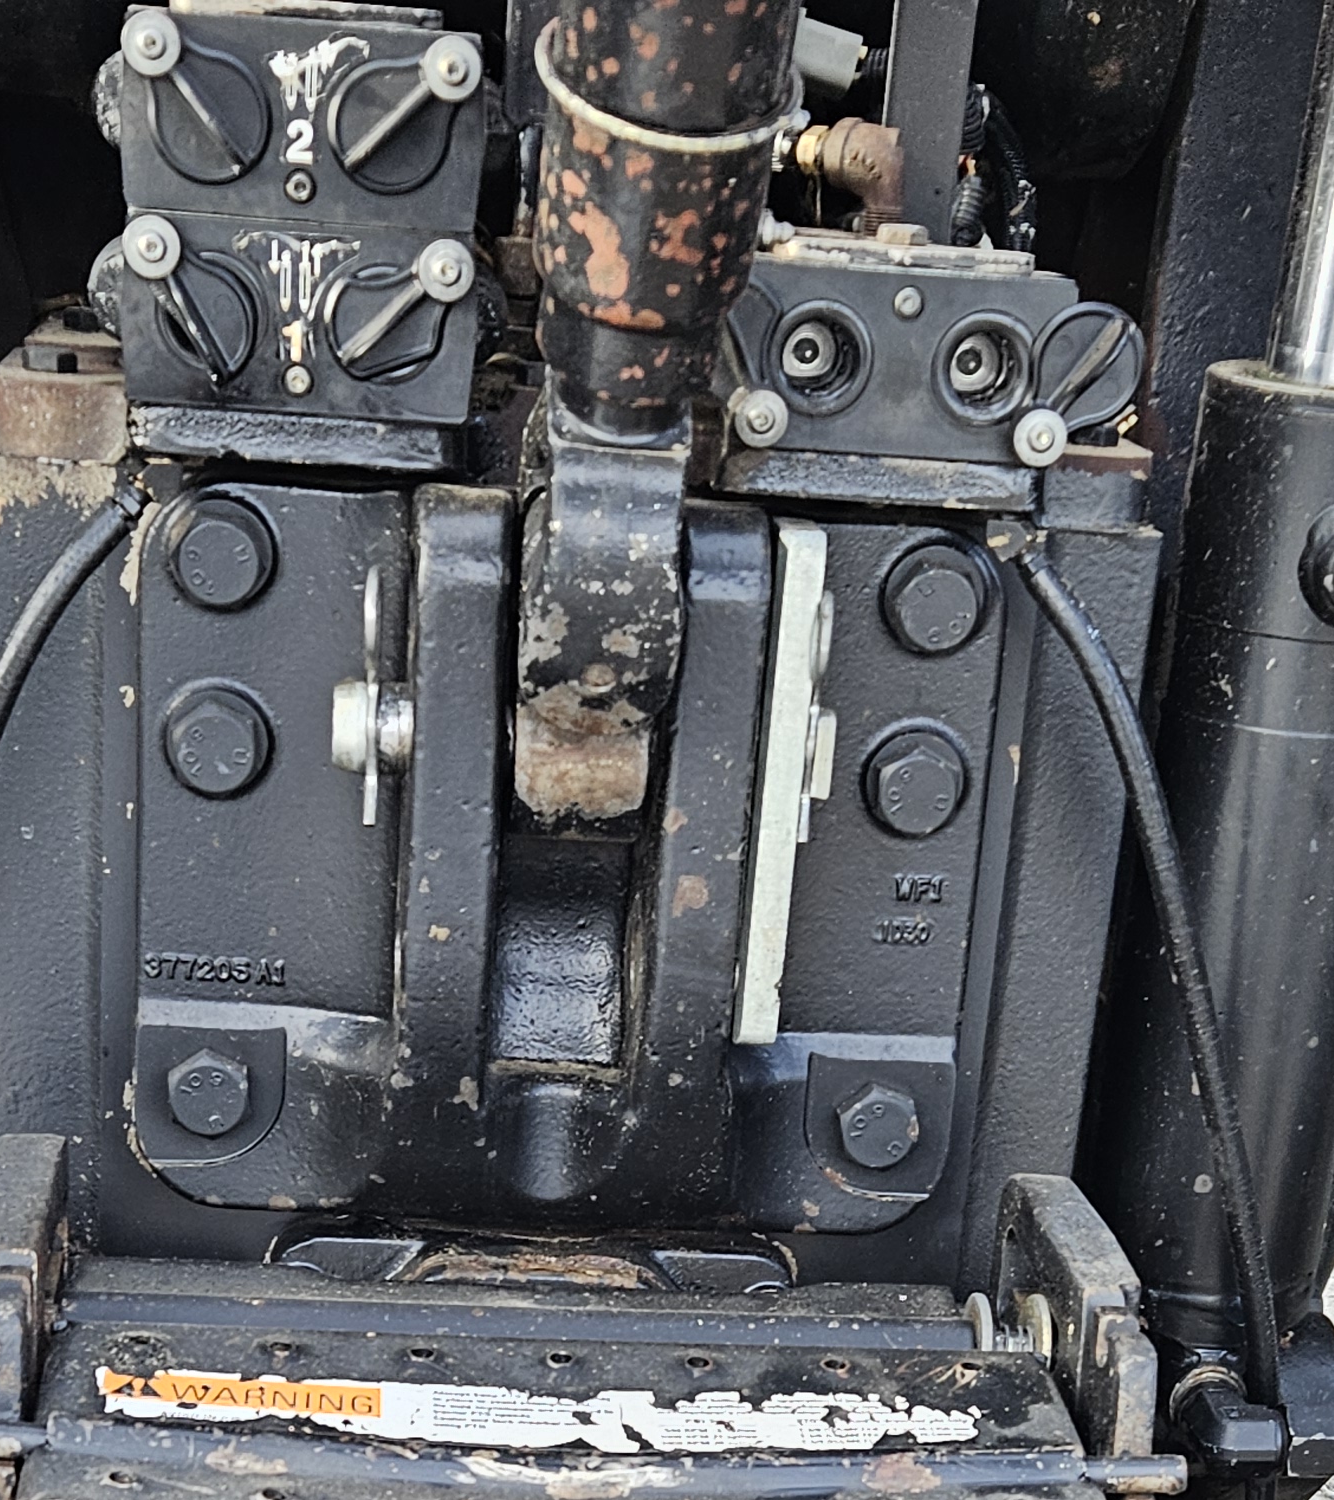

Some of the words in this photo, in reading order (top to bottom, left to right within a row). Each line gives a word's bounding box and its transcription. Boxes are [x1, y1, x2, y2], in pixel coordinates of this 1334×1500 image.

[285, 118, 314, 166] 2
[281, 319, 303, 364] 1
[170, 1381, 376, 1415] WARNING
